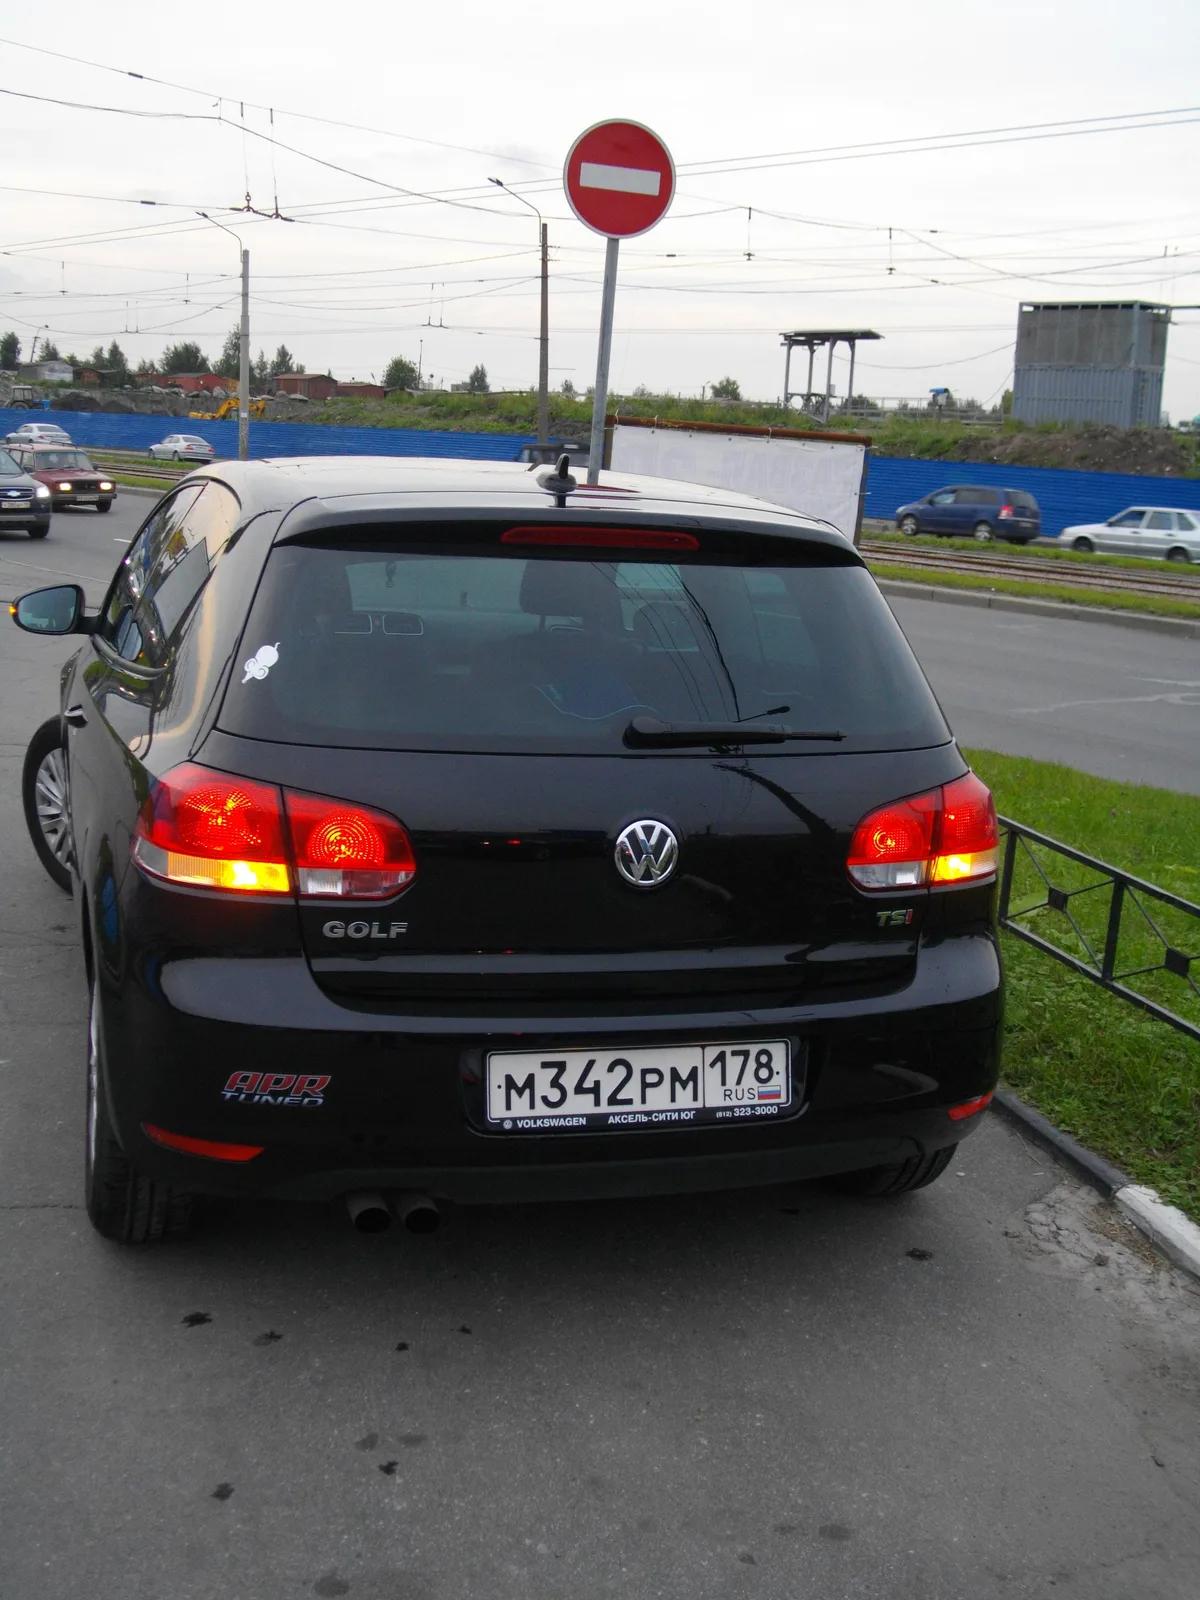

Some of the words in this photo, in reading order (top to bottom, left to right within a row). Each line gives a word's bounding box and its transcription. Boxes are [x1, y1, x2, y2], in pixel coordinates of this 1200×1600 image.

[322, 920, 408, 939] GOLF
[709, 1049, 774, 1086] 178
[224, 1071, 332, 1097] APR
[221, 1092, 324, 1107] TUNED
[723, 1088, 756, 1101] RUS
[608, 1112, 678, 1124] АКСЕЛЬ-СИТИ
[680, 1111, 696, 1120] ЮГ
[716, 1111, 732, 1119] (812)
[733, 1106, 778, 1117] 323-3000
[517, 1117, 586, 1128] VOLKSWAGEN
